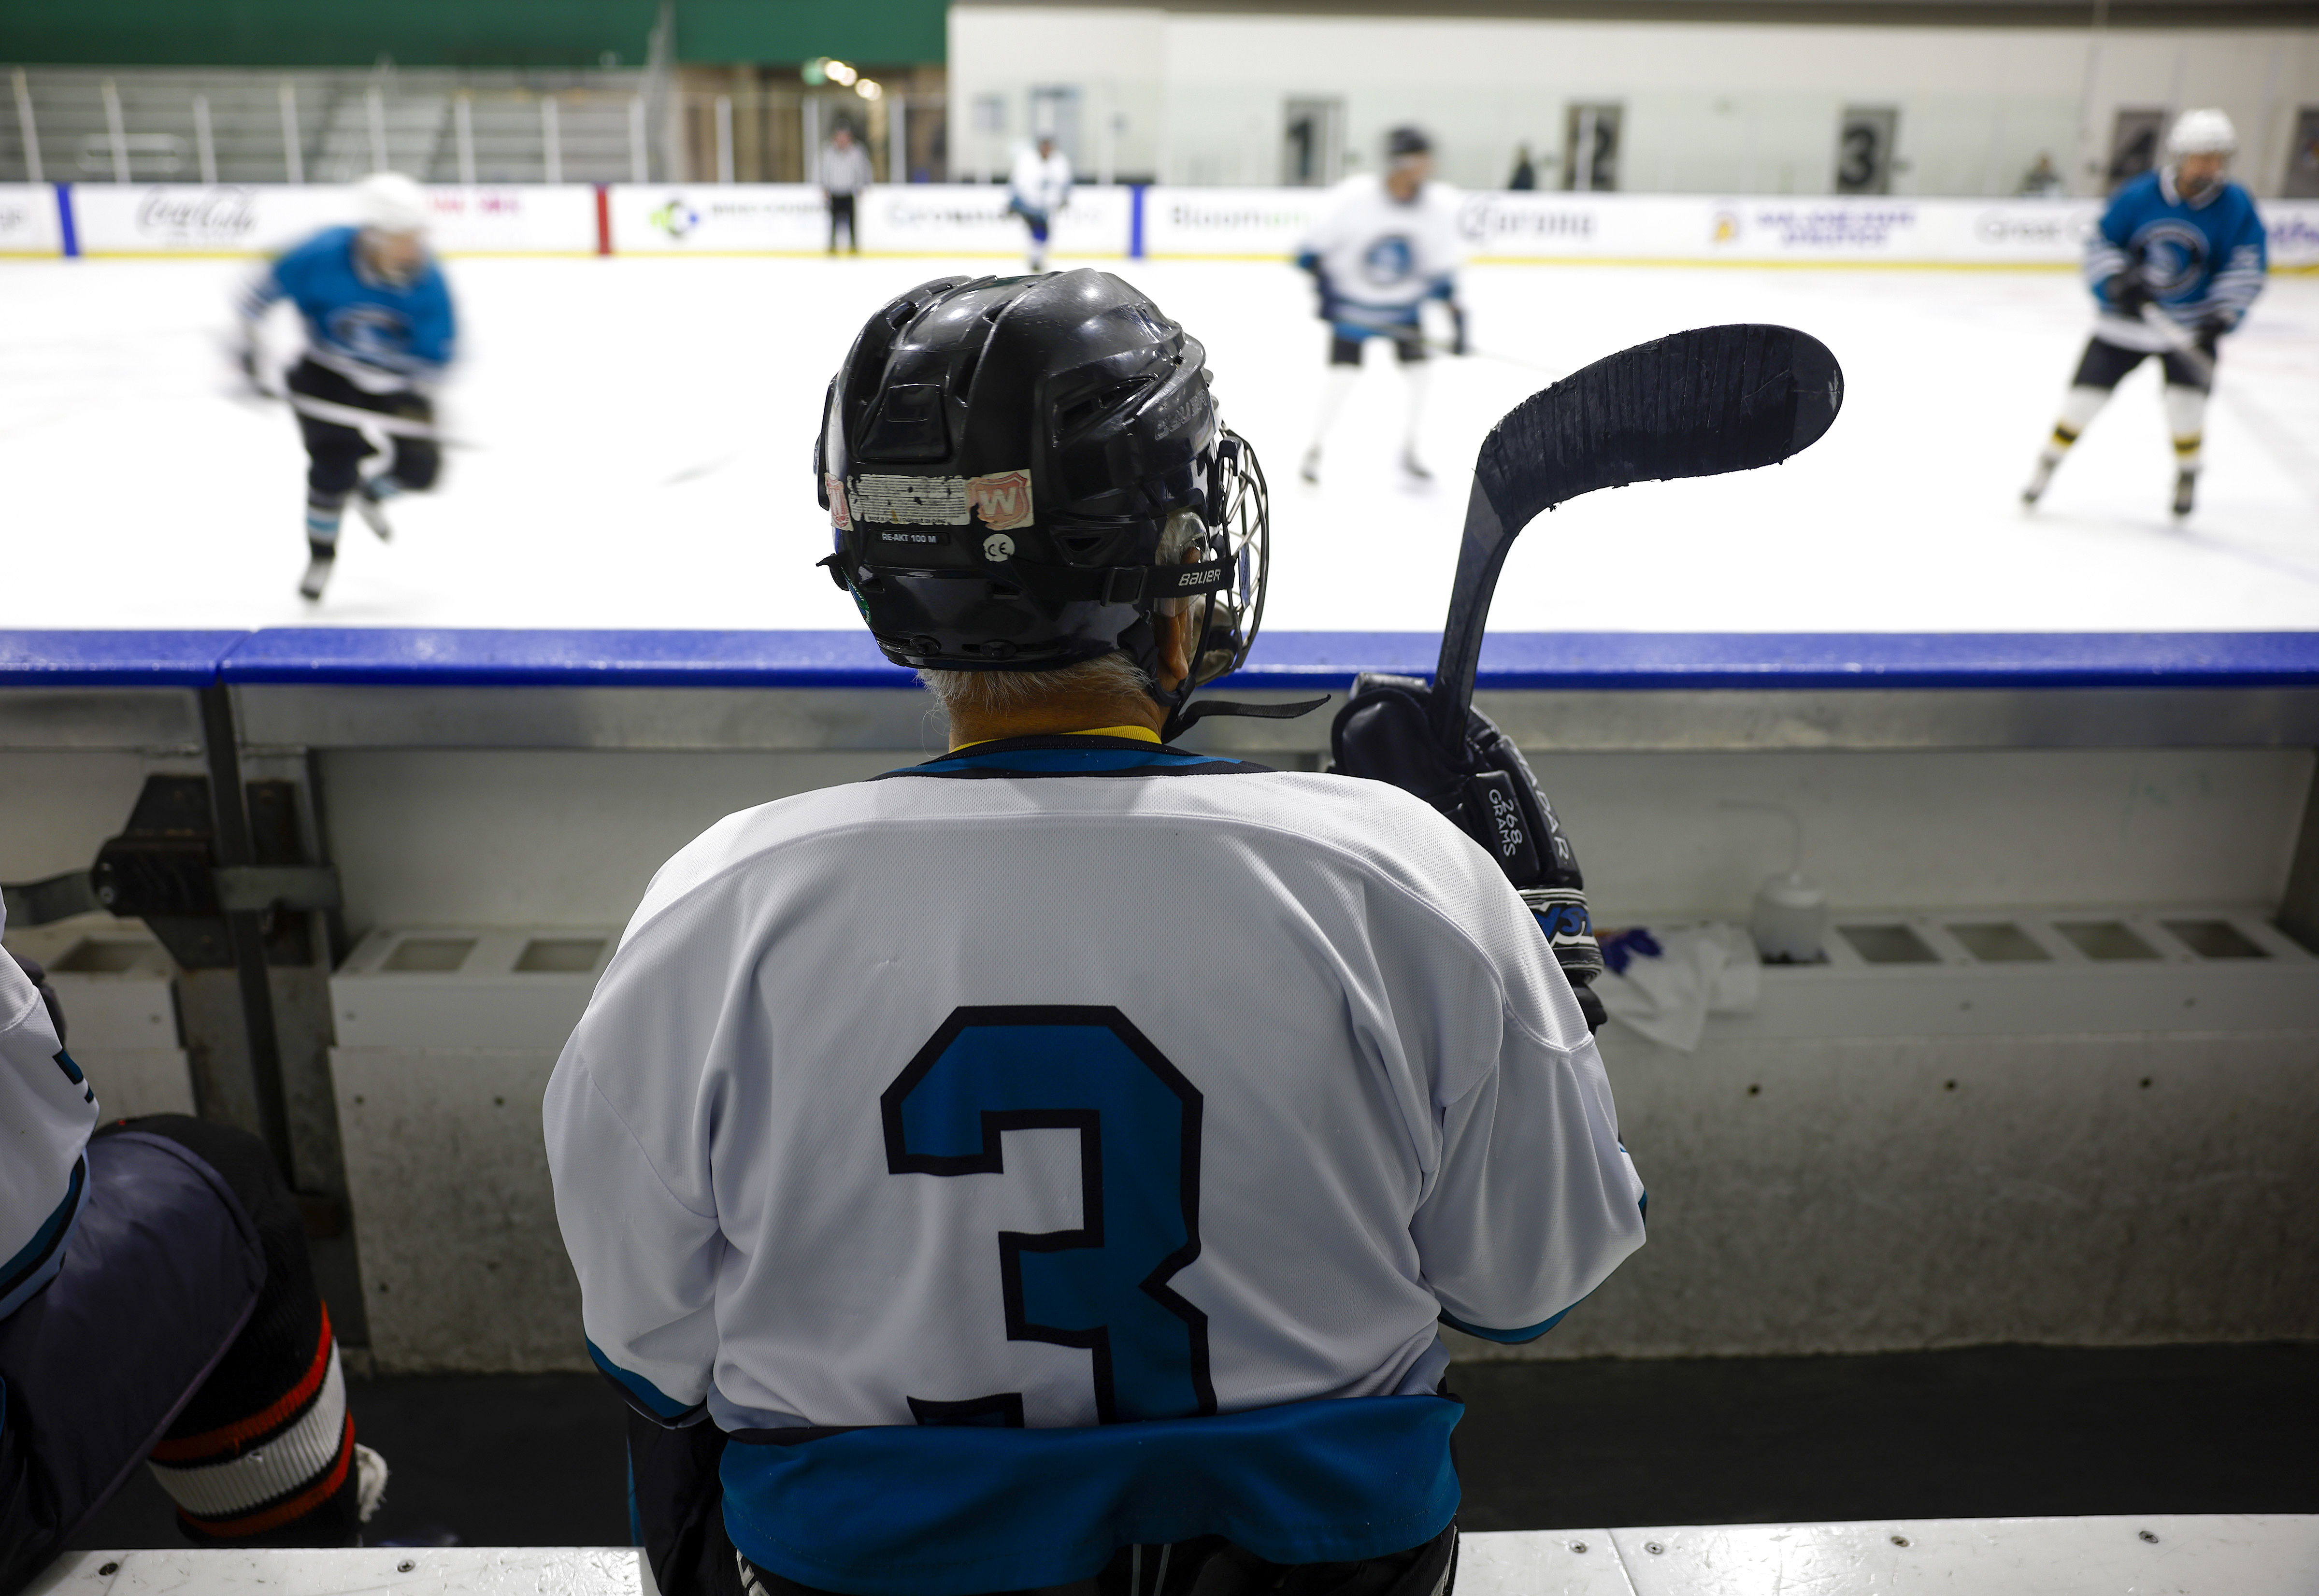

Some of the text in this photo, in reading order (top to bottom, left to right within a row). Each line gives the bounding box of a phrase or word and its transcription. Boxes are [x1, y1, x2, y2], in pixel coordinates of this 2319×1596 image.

[1839, 125, 1877, 186] 3
[881, 533, 909, 542] RE-AKT
[988, 542, 1010, 556] CE
[1489, 789, 1516, 857] GRAMS
[1501, 798, 1523, 844] 268
[880, 1005, 1217, 1428] 3
